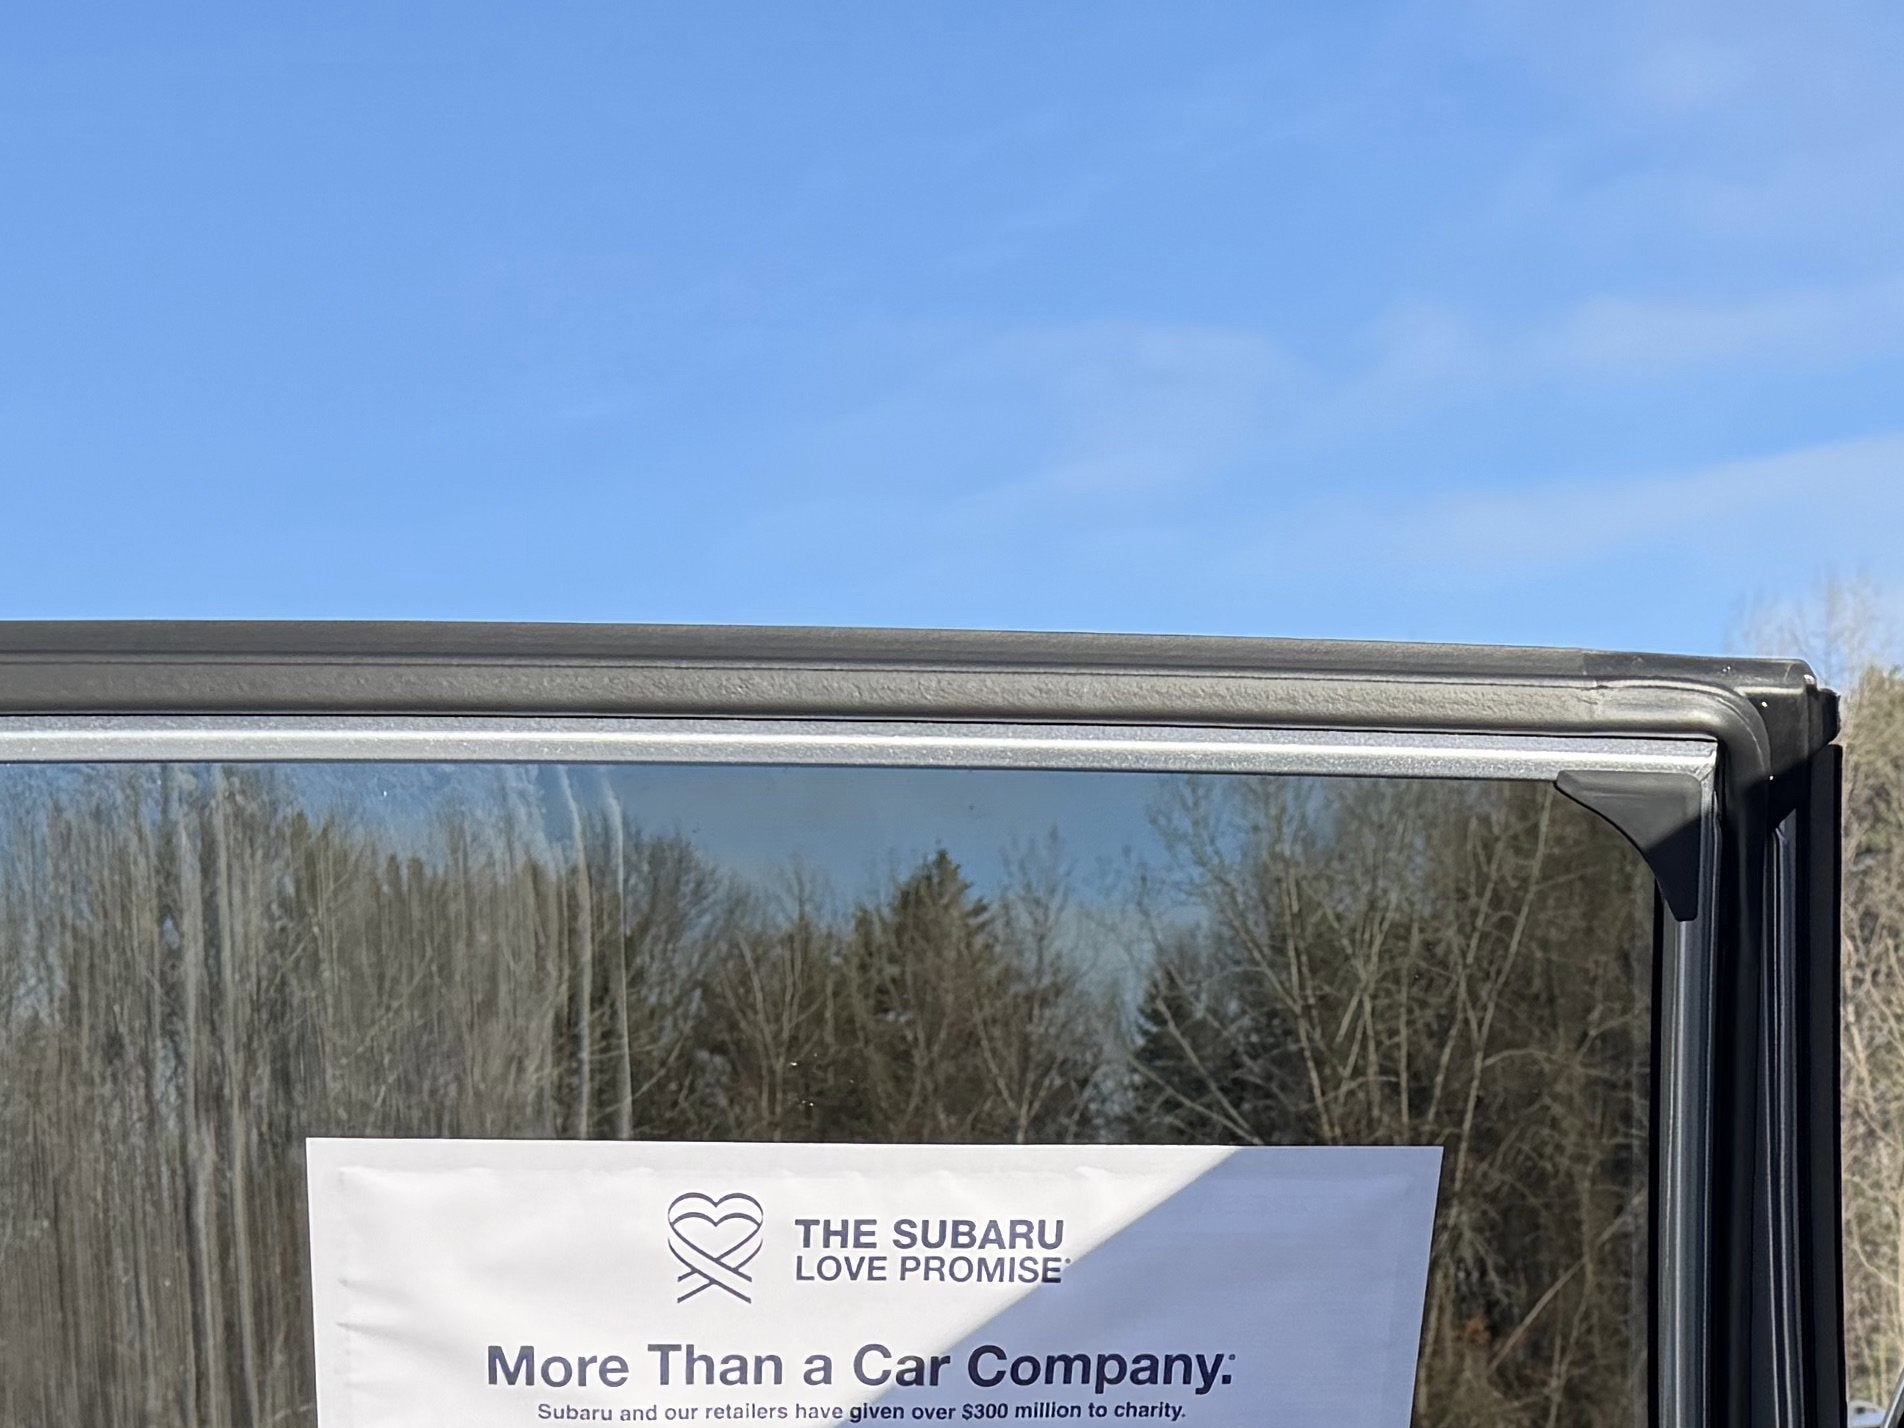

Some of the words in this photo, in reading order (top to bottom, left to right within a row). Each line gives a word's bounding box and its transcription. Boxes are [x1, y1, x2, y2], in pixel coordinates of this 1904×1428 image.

[795, 1219, 877, 1249] THE
[893, 1219, 1063, 1250] SUBARU
[796, 1256, 887, 1281] LOVE
[900, 1256, 1061, 1283] PROMISE
[488, 1346, 629, 1387] More
[648, 1344, 782, 1385] Than
[804, 1355, 832, 1385] a
[854, 1344, 951, 1386] Car
[968, 1345, 1235, 1395] Company.
[538, 1404, 612, 1421] Subaru
[620, 1405, 657, 1421] and
[665, 1408, 698, 1420] our
[706, 1403, 788, 1419] retailers
[796, 1403, 843, 1419] have
[850, 1403, 904, 1423] given
[912, 1407, 956, 1420] over
[962, 1403, 1008, 1420] $300
[1015, 1402, 1081, 1418] million
[1088, 1402, 1107, 1417] to
[1114, 1402, 1185, 1421] charity.
